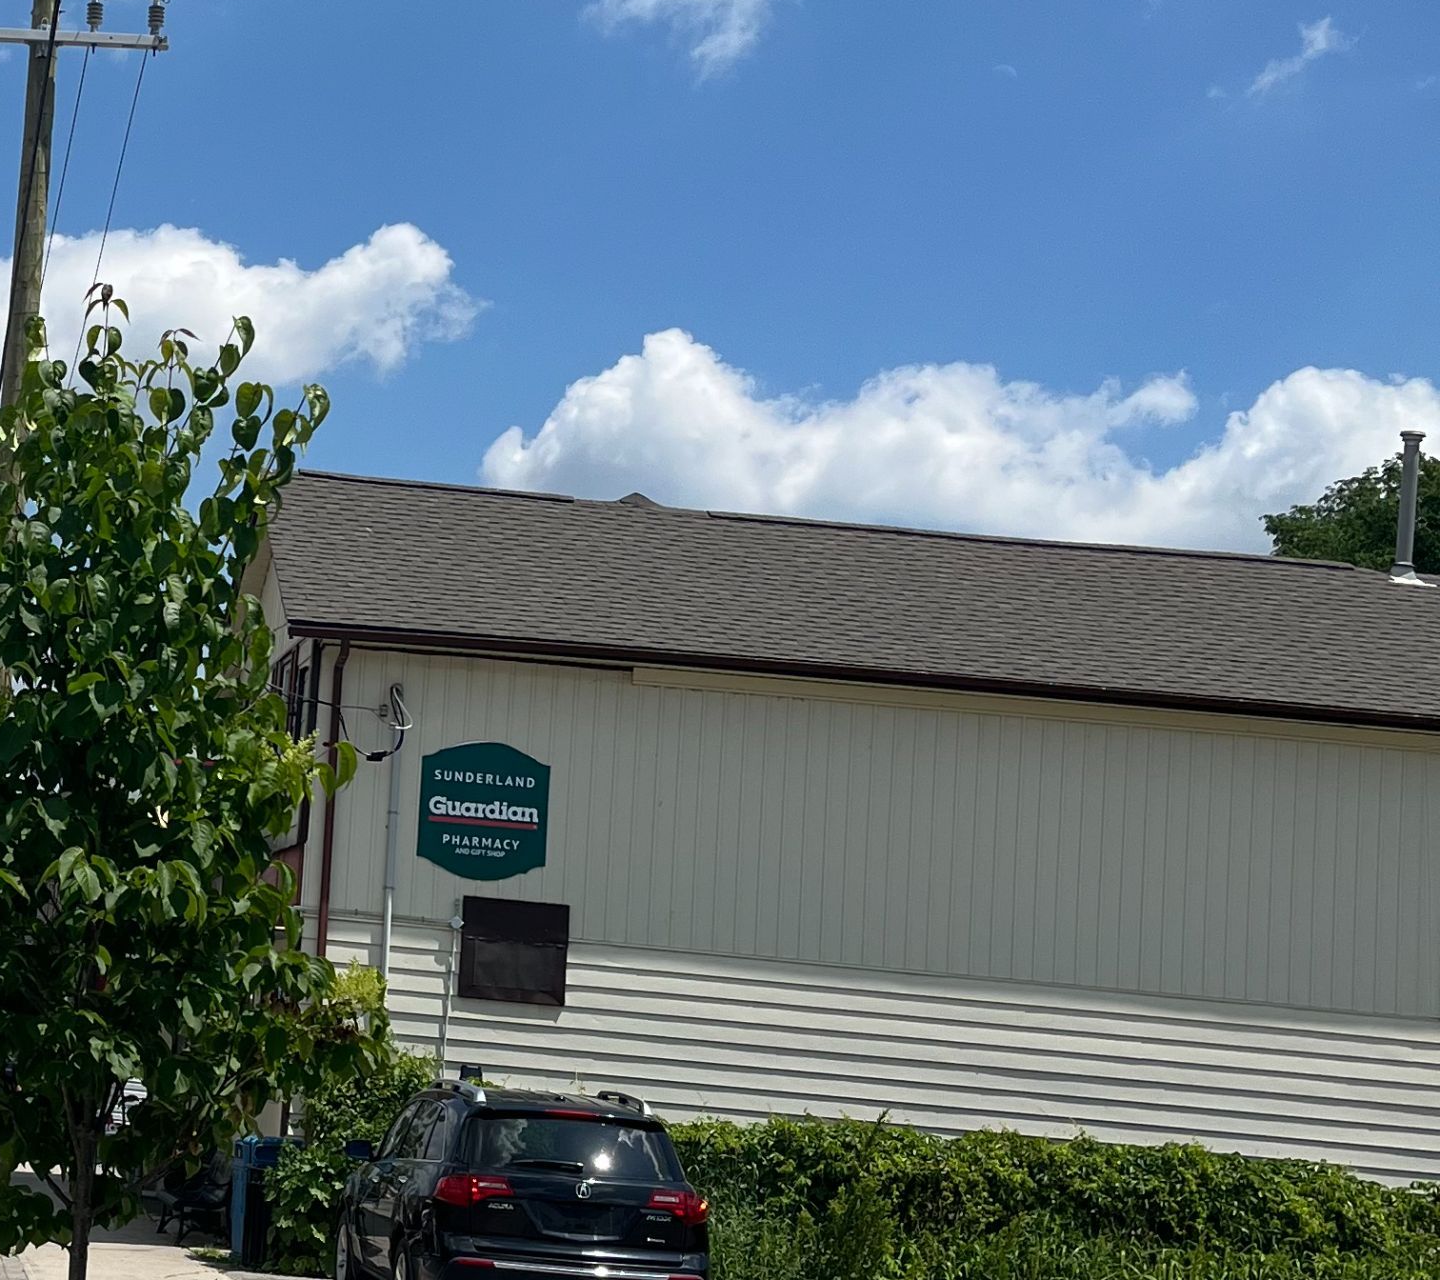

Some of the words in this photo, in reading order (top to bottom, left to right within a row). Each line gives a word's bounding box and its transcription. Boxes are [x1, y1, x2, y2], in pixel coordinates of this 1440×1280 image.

[433, 769, 536, 789] SUNDERLAND
[428, 795, 539, 823] Guardian
[442, 833, 520, 851] PHARMACY
[454, 847, 470, 855] AND
[486, 849, 506, 857] SHOP
[487, 1202, 515, 1210] ACURA
[645, 1214, 672, 1222] MDX
